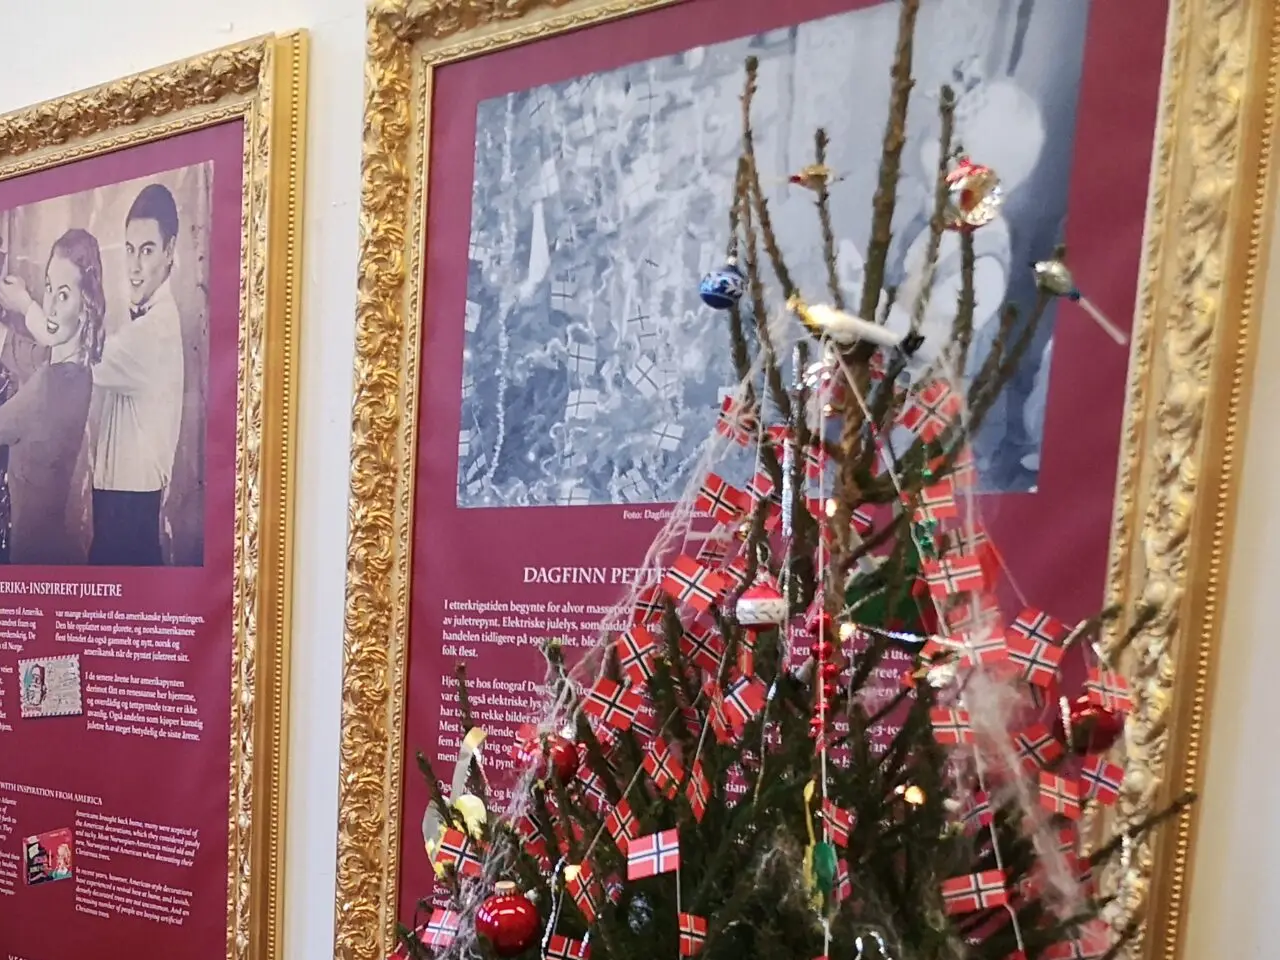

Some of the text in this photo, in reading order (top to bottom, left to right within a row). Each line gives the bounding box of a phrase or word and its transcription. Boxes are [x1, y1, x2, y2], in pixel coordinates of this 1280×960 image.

[623, 509, 641, 520] Foto:
[523, 566, 667, 584] DAGFINN PETTE
[80, 583, 122, 598] JULETRE
[449, 600, 508, 614] etterkrigstiden
[510, 602, 545, 616] begynte
[547, 602, 560, 612] for
[562, 602, 584, 613] alvor
[443, 617, 452, 626] av
[454, 616, 500, 629] juletrepynt.
[502, 617, 545, 628] Elektriske
[547, 618, 578, 631] julelys,
[580, 621, 599, 630] som
[442, 630, 479, 642] handelen
[481, 631, 515, 645] tidligere
[517, 633, 527, 646] på
[581, 635, 596, 647] ble
[442, 645, 478, 657] folk flest.
[476, 677, 491, 689] hos
[492, 678, 527, 693] fotograf
[441, 693, 453, 701] var
[468, 694, 485, 706] også
[487, 694, 528, 707] elektriske
[530, 697, 541, 711] lys
[440, 705, 453, 716] har
[470, 710, 479, 719] en
[481, 709, 504, 721] rekke
[505, 710, 529, 723] bilder
[439, 721, 458, 732] Mest
[438, 735, 453, 746] fem
[485, 740, 500, 754] krig
[502, 745, 512, 754] og
[0, 781, 102, 805] WITH INSPIRATION FROM AMERICA
[493, 789, 504, 800] og
